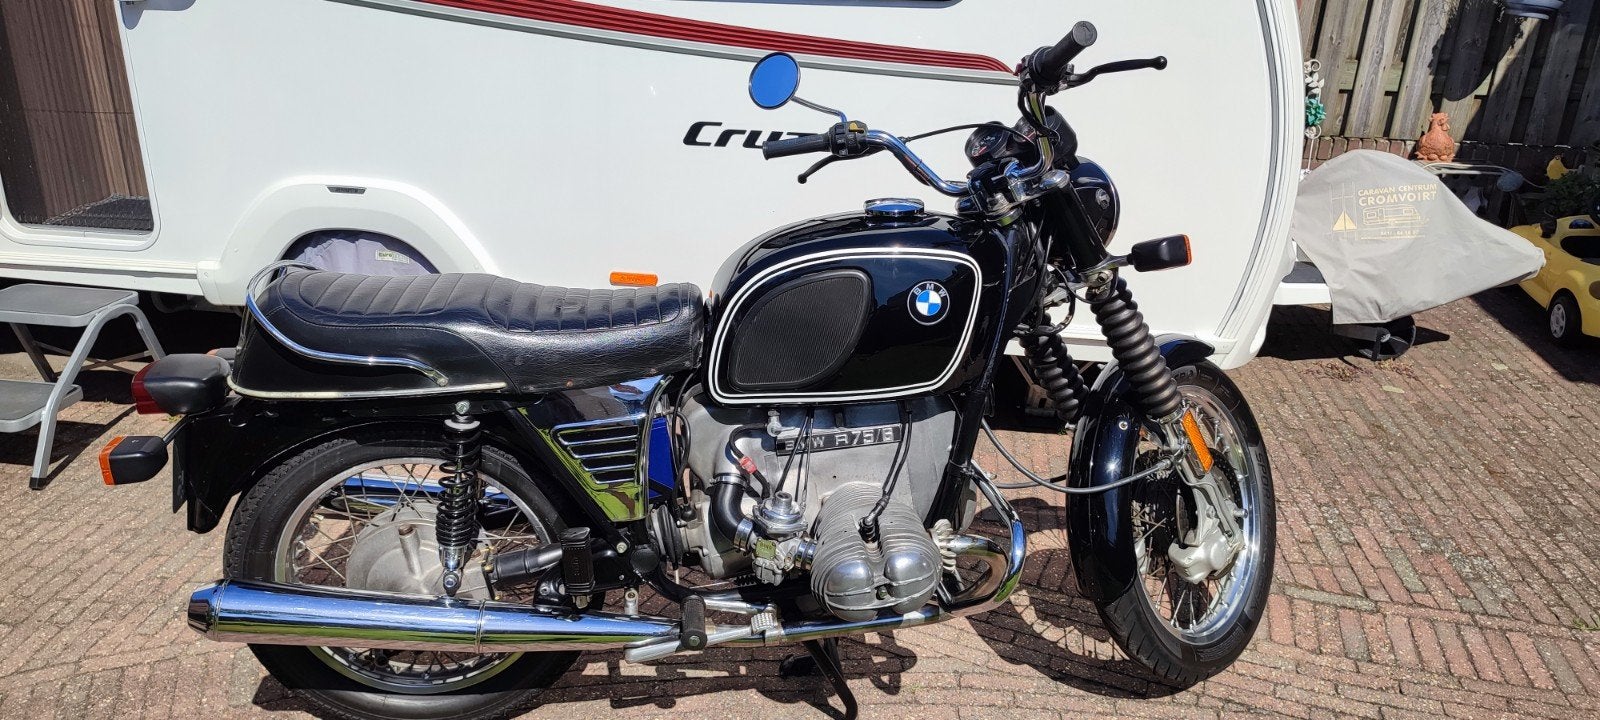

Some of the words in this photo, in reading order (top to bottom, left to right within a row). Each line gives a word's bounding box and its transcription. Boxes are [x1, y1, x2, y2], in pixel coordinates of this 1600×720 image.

[1358, 187, 1396, 197] CARAVAN
[1398, 184, 1437, 193] CENTRUM
[1359, 191, 1437, 206] CROMVOIRT
[913, 283, 947, 298] BMW
